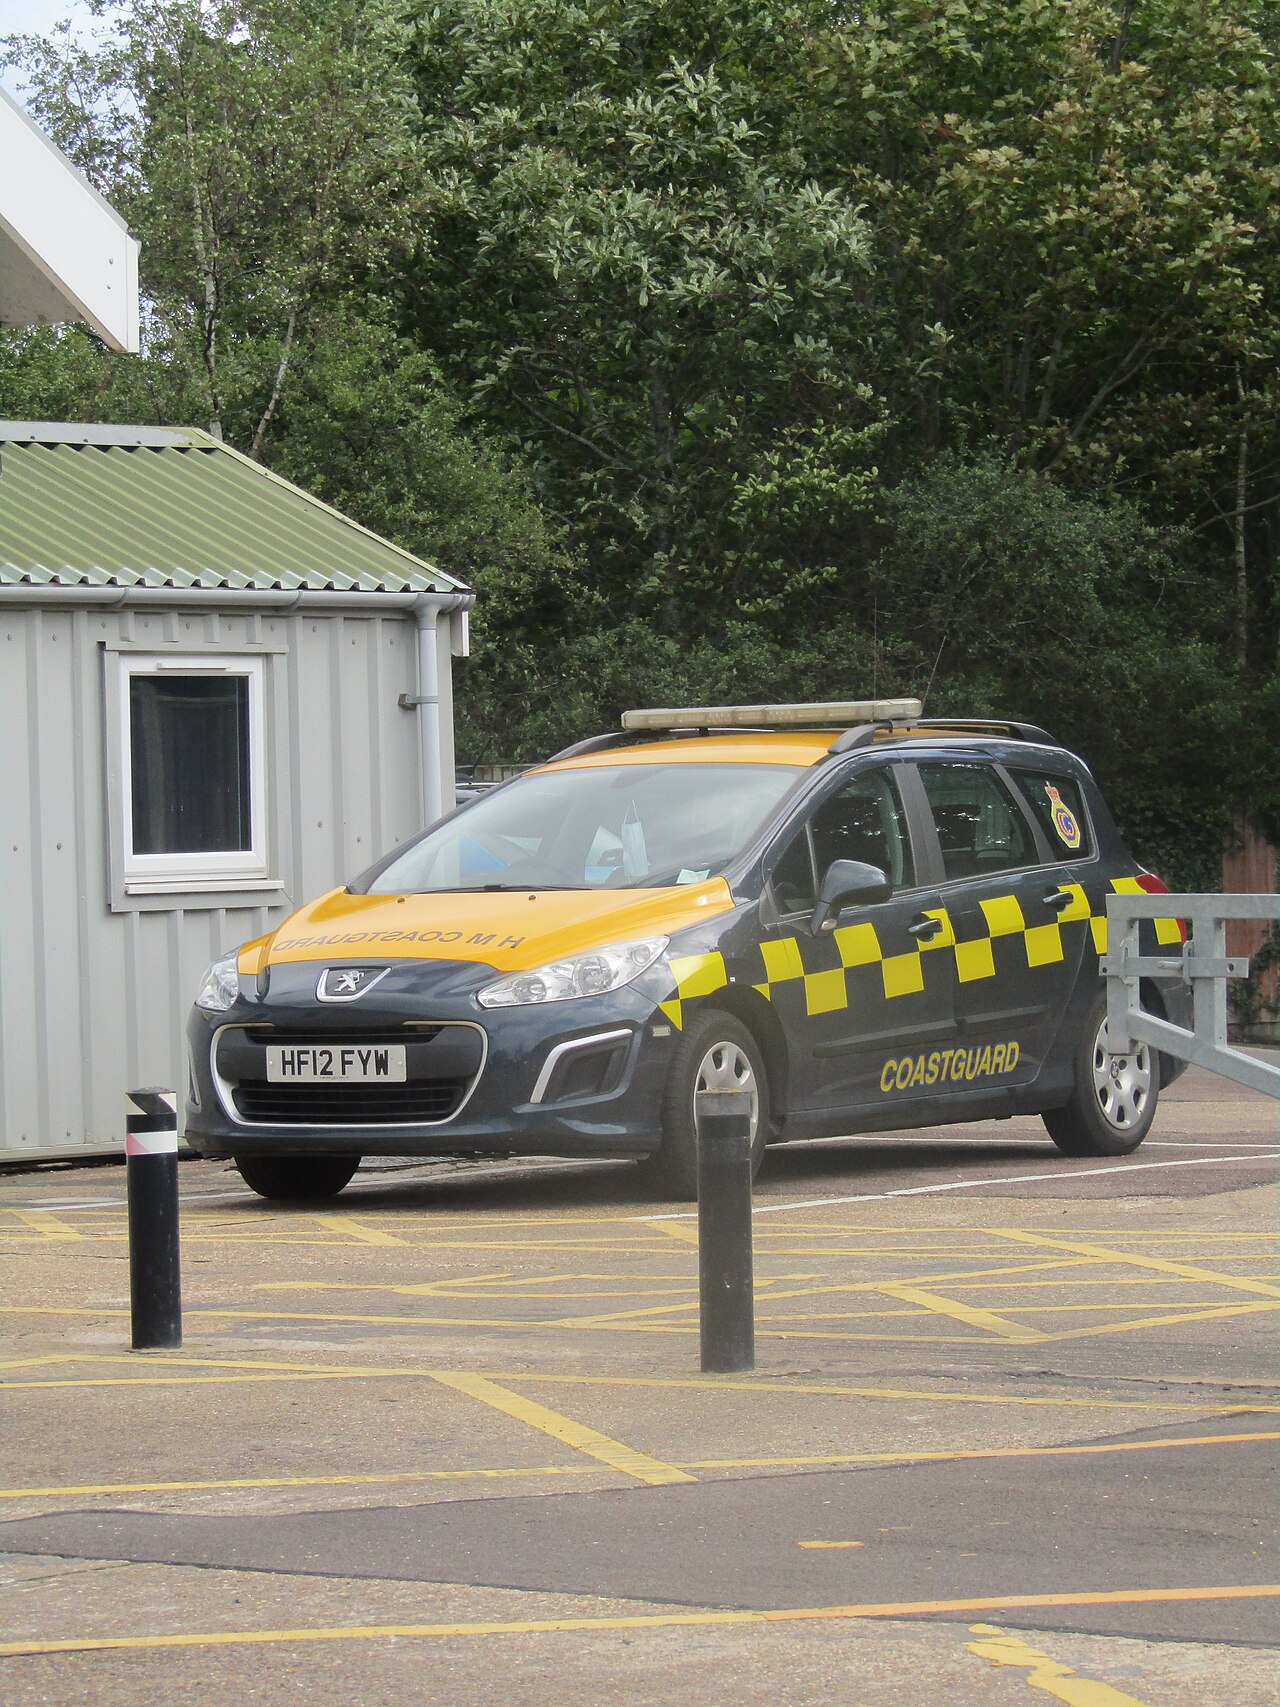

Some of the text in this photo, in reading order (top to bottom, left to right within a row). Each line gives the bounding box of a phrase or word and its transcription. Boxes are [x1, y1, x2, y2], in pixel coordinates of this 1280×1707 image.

[281, 1049, 389, 1076] HF12 FYW
[880, 1041, 1020, 1092] COASTGUARD
